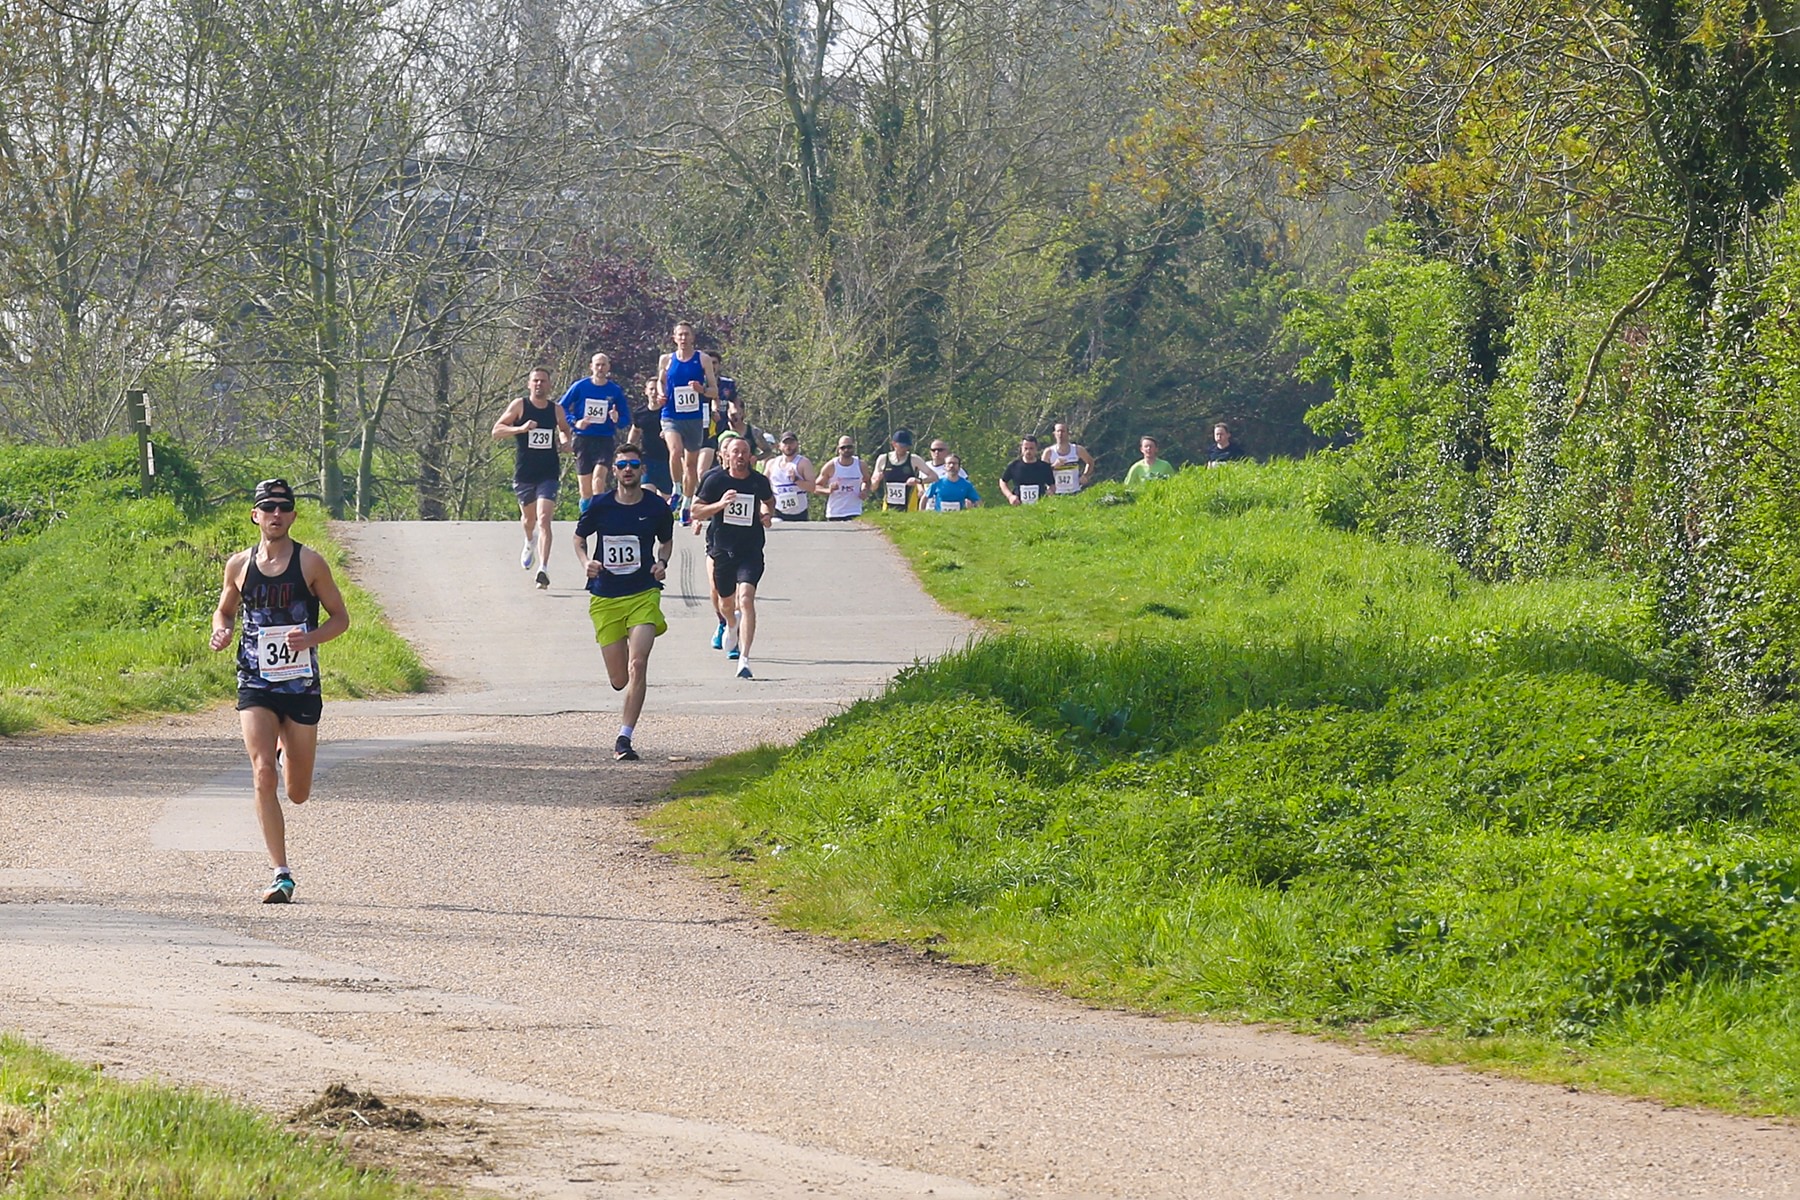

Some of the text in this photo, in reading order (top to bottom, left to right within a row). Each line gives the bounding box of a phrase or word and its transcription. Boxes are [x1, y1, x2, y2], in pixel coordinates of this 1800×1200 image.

[678, 393, 695, 405] 310
[587, 406, 603, 417] 364
[532, 432, 550, 444] 239
[1057, 475, 1071, 484] 342
[889, 488, 903, 499] 345
[1023, 490, 1037, 499] 315
[728, 502, 748, 516] 331
[781, 498, 796, 509] 248
[608, 546, 634, 563] 313
